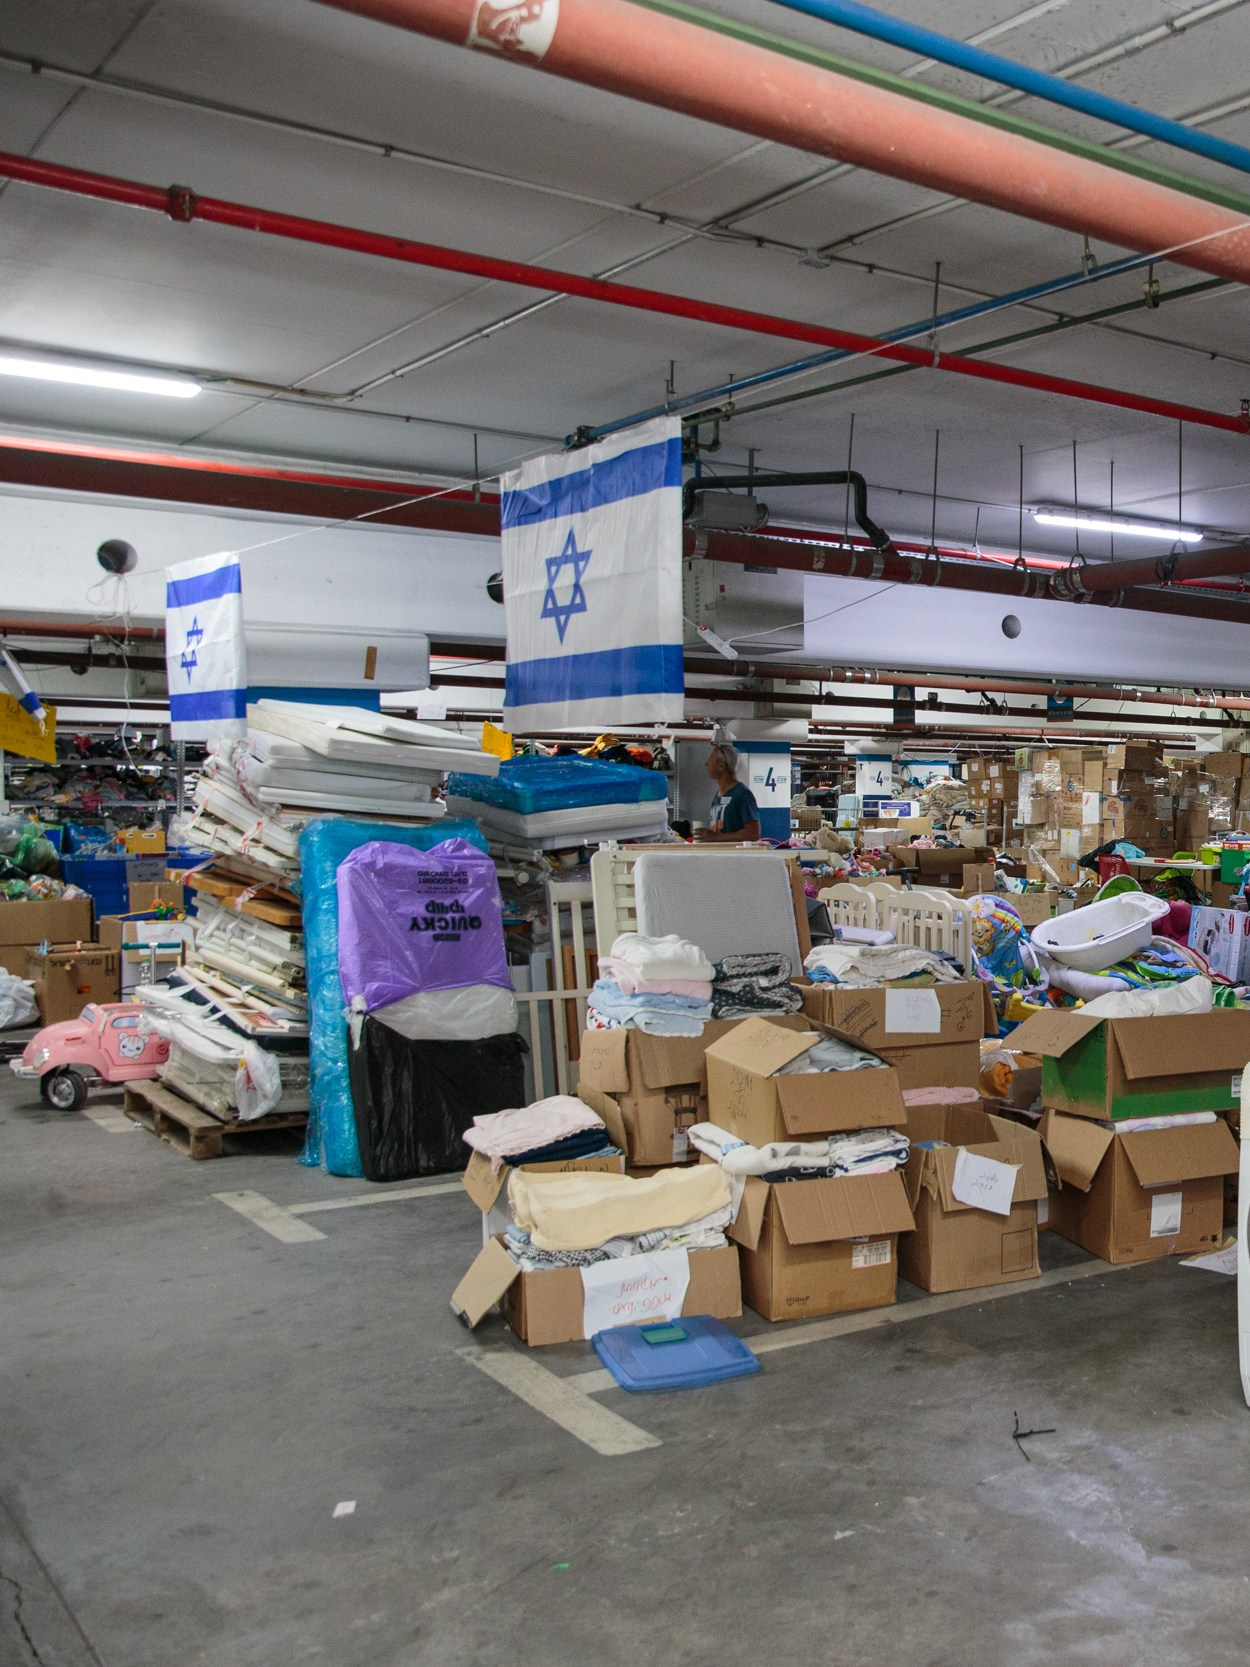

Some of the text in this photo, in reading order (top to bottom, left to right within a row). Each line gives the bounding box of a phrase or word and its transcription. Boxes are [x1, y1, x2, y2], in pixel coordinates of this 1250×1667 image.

[765, 767, 777, 792] 4
[876, 771, 884, 787] 4
[409, 915, 482, 931] QUICKY
